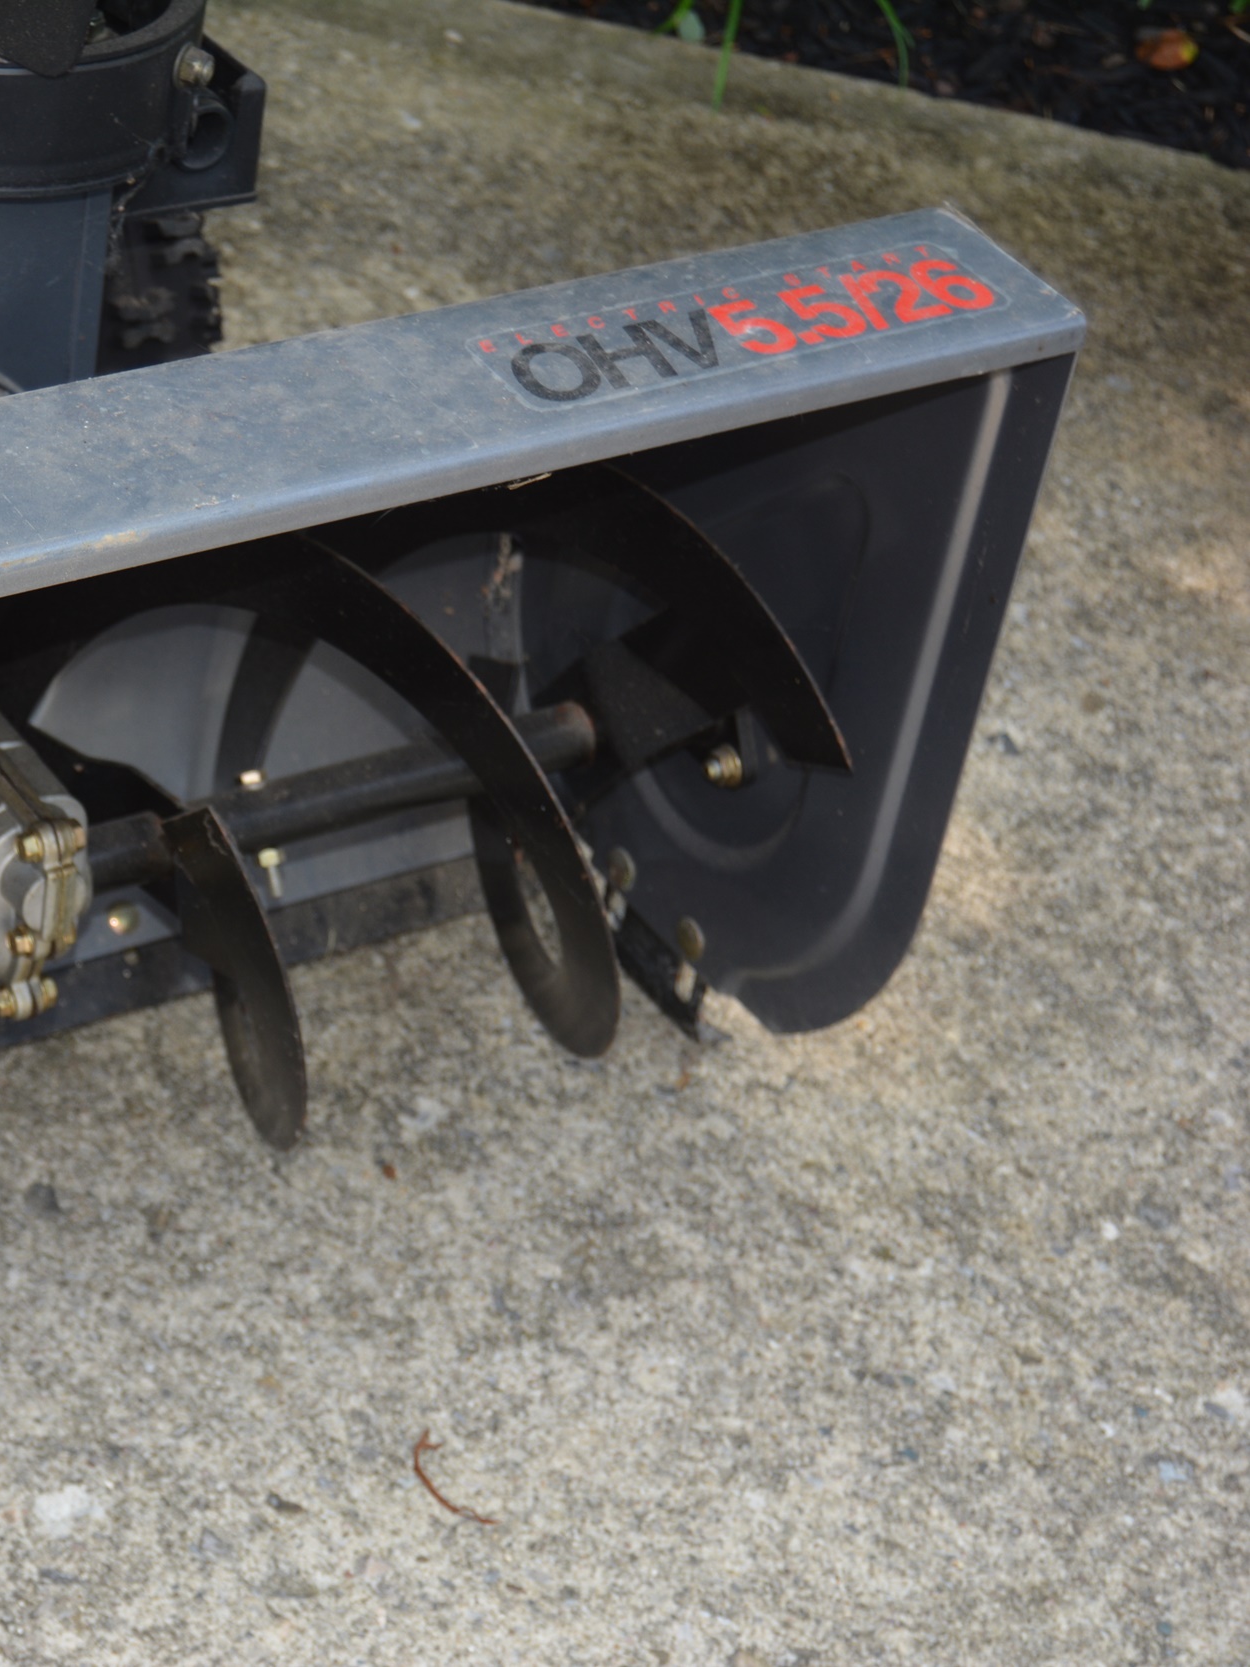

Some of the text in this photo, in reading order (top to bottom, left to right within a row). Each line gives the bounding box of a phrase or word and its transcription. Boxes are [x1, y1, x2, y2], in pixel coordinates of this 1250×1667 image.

[478, 286, 740, 353] ELECTRIC
[510, 259, 995, 402] OHV 5.5/26
